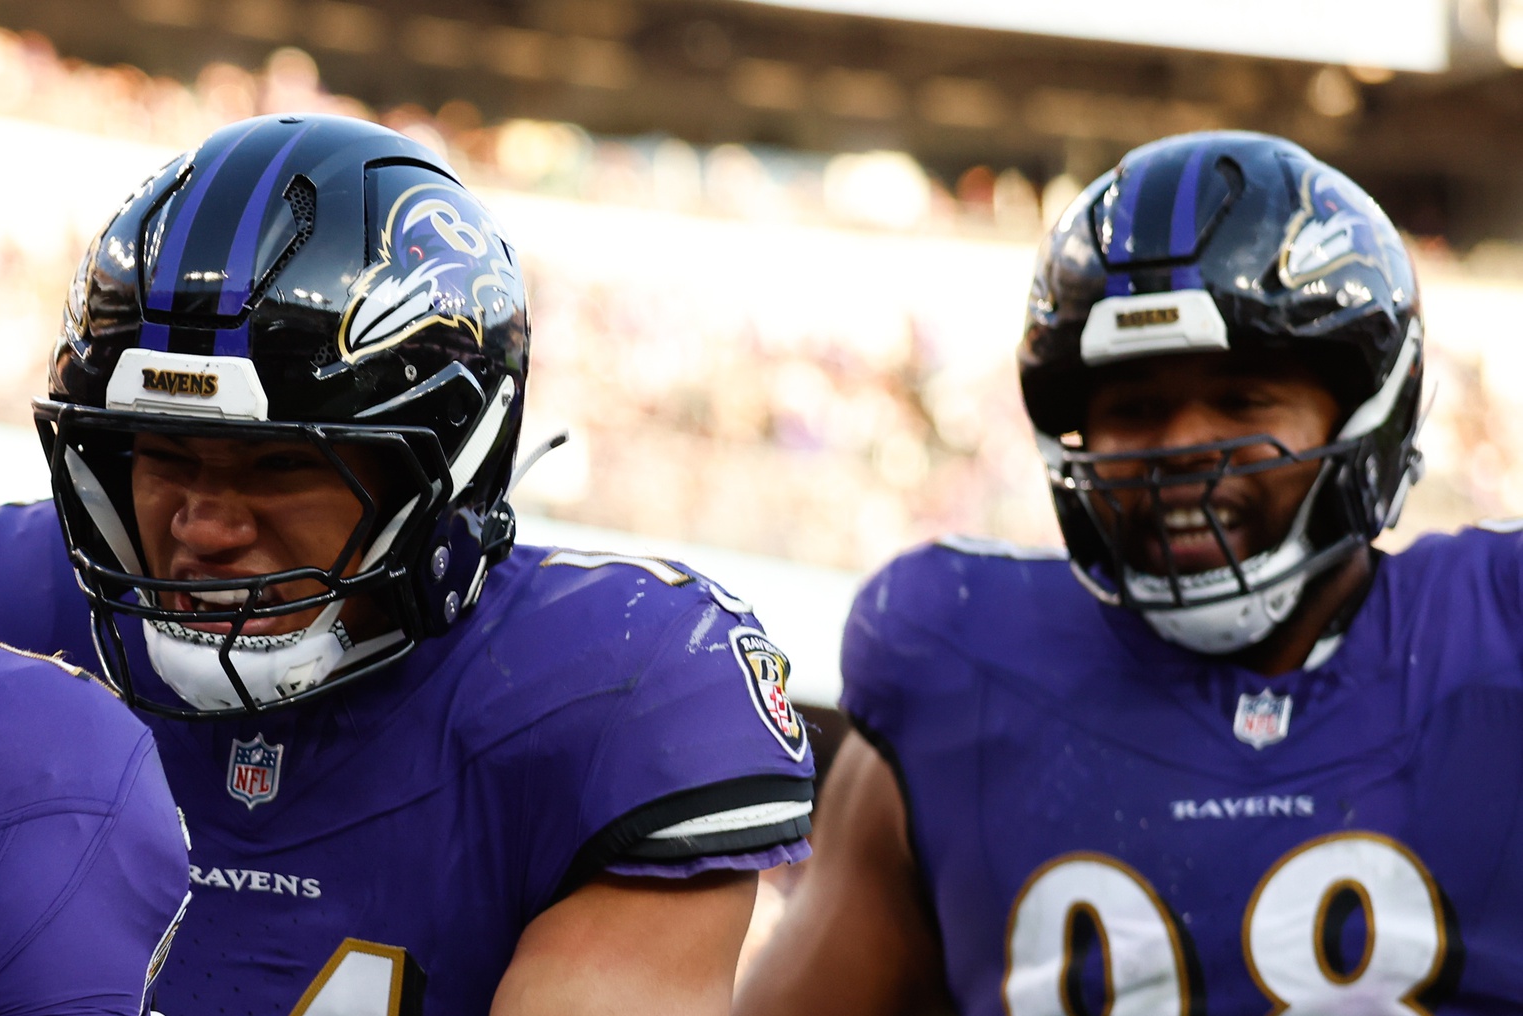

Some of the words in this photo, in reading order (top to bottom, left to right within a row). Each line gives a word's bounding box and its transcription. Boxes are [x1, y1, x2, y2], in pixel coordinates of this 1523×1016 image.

[141, 367, 219, 397] RAVENS
[234, 765, 270, 795] NFL
[1171, 794, 1315, 822] RAVENS
